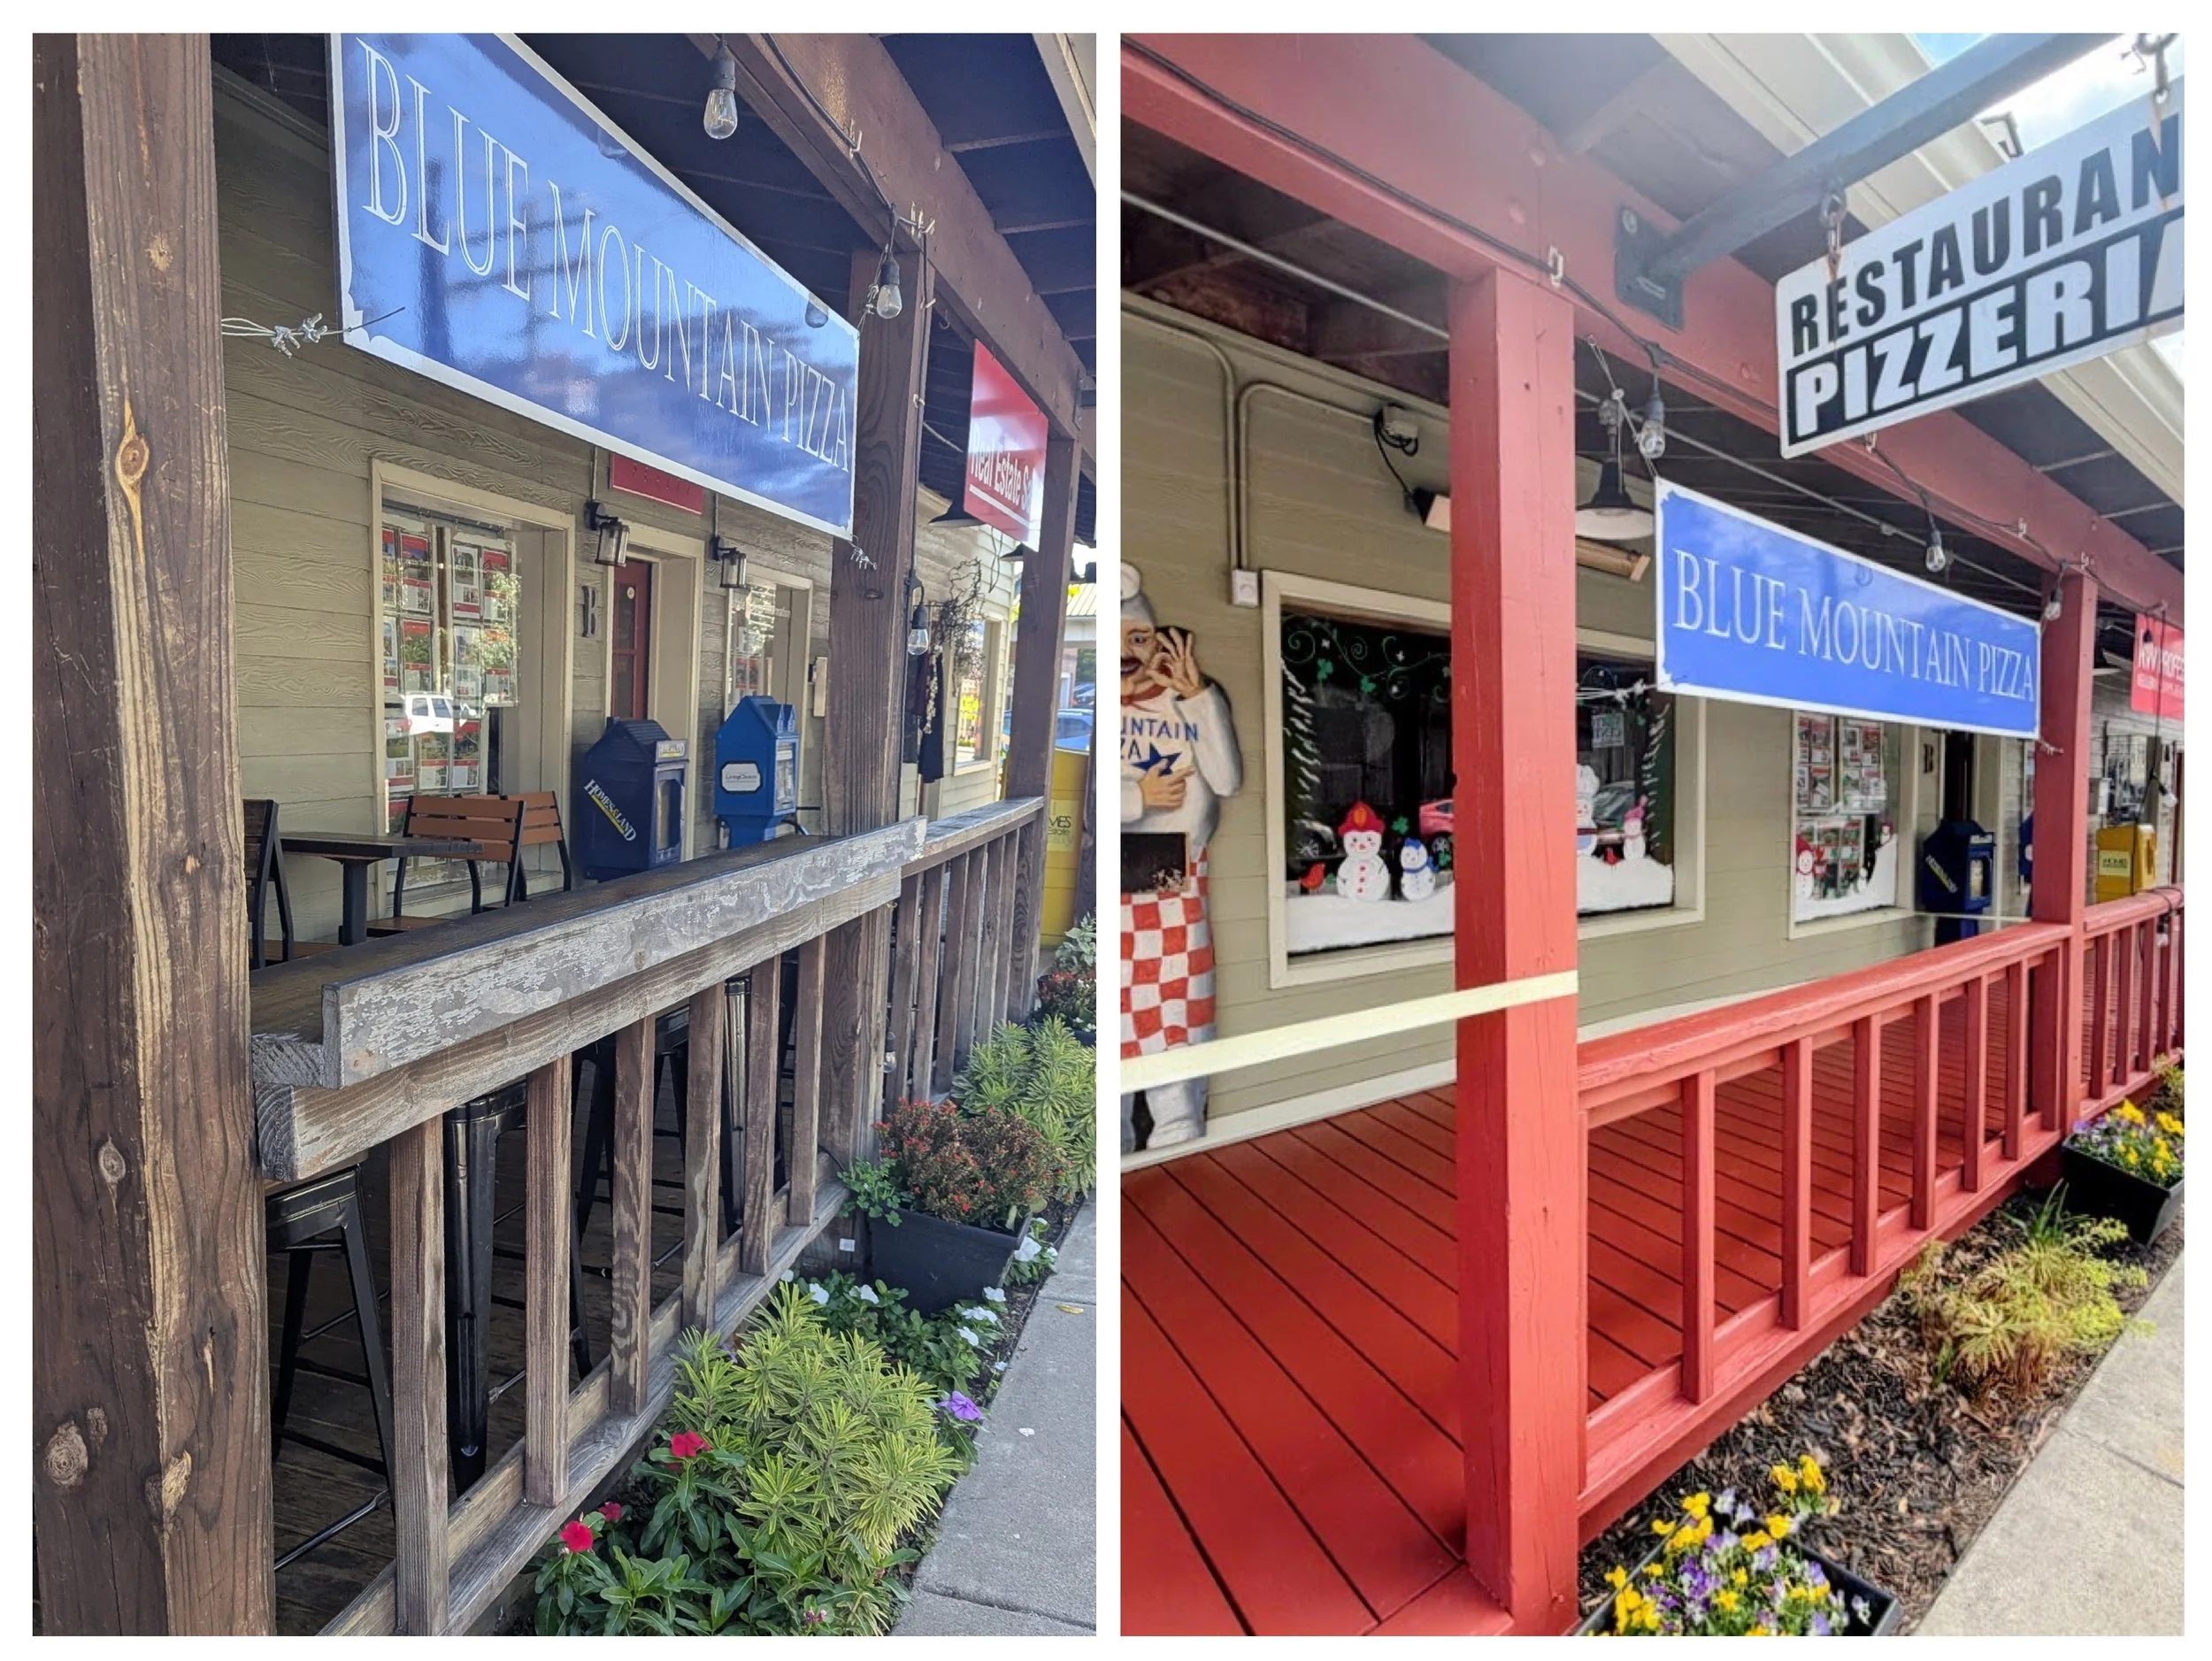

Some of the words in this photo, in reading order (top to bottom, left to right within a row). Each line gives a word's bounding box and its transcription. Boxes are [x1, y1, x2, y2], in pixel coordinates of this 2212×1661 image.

[356, 36, 531, 302] BLUE
[547, 180, 775, 434] MOUNTAIN
[781, 350, 849, 473] PIZZA
[1790, 112, 2181, 358] RESTAURAN
[995, 442, 1022, 506] Estate
[581, 586, 598, 637] B
[1671, 548, 1786, 650] BLUE
[1798, 588, 1971, 689] MOUNTAIN
[1978, 641, 2035, 703] PIZZA
